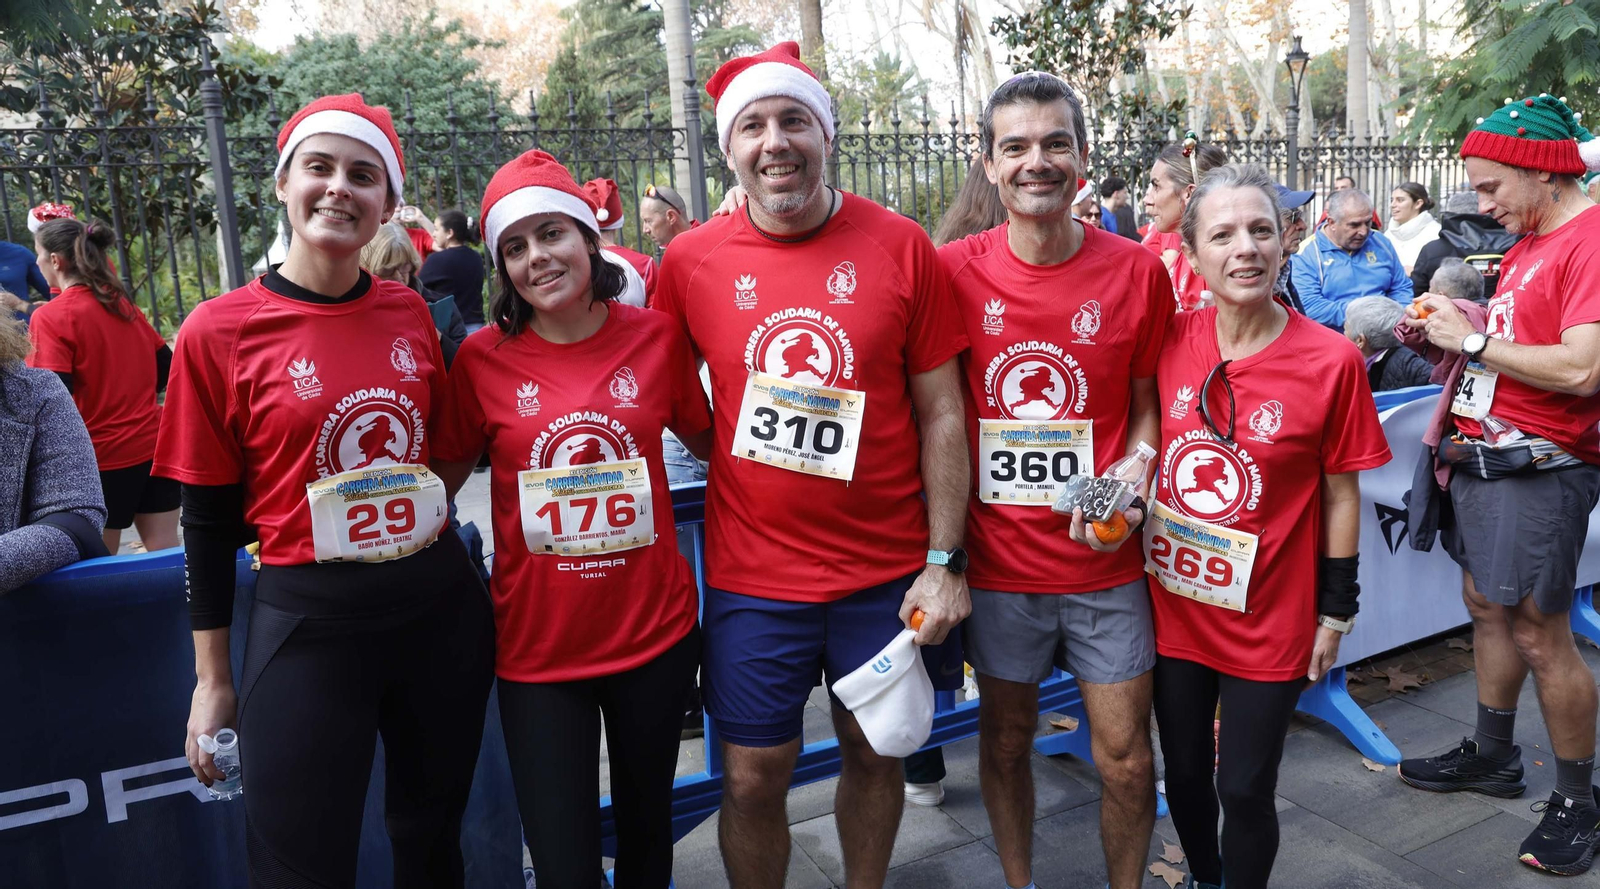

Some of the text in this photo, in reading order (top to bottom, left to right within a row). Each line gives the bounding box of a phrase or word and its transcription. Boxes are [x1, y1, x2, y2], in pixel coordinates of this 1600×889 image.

[736, 290, 757, 300] UCA
[984, 315, 1003, 326] UCA
[744, 307, 855, 380] CARRERA SOLIDARIA DE NAVIDAD
[293, 375, 321, 390] UCA
[985, 340, 1089, 414] XI CARRERA SOLIDARIA DE NAVIDAD
[517, 397, 540, 408] UCA
[769, 385, 805, 405] CARRERA
[805, 394, 841, 412] NAVIDAD
[1173, 400, 1189, 411] UCA
[315, 412, 340, 466] CARRERA
[335, 387, 397, 414] SOLIDARIA
[398, 394, 414, 411] DE
[410, 407, 425, 461] NAVIDAD
[750, 406, 845, 455] 310
[1000, 429, 1072, 442] CARRERA NAVIDAD
[529, 410, 640, 470] ARRERA SOLIDARIA DE NAVI
[764, 443, 825, 462] MORENO PÉREZ, JOSÉ ÁNGEL
[1163, 435, 1185, 475] CARRERA
[1237, 448, 1253, 464] DE
[990, 450, 1079, 483] 360
[336, 473, 418, 496] CARRERA NAVIDAD
[545, 470, 624, 491] CARRERA NAVIDAD
[1162, 477, 1169, 489] XI
[1247, 464, 1263, 511] NAVIDAD
[535, 492, 637, 536] 176
[1167, 497, 1187, 517] CIUD
[346, 497, 417, 543] 29
[374, 538, 393, 549] NÚÑEZ,
[393, 534, 413, 544] BEATRIZ
[554, 528, 626, 543] GONZÁLEZ BARRIENTOS, MARÍA
[1164, 517, 1232, 552] CARRERA NAVIDAD
[557, 558, 626, 571] CUPRA
[1150, 534, 1233, 587] 269
[1162, 571, 1178, 581] MARTIN
[1181, 578, 1193, 586] MARI
[1193, 582, 1213, 592] CARMEN
[0, 756, 214, 831] PR
